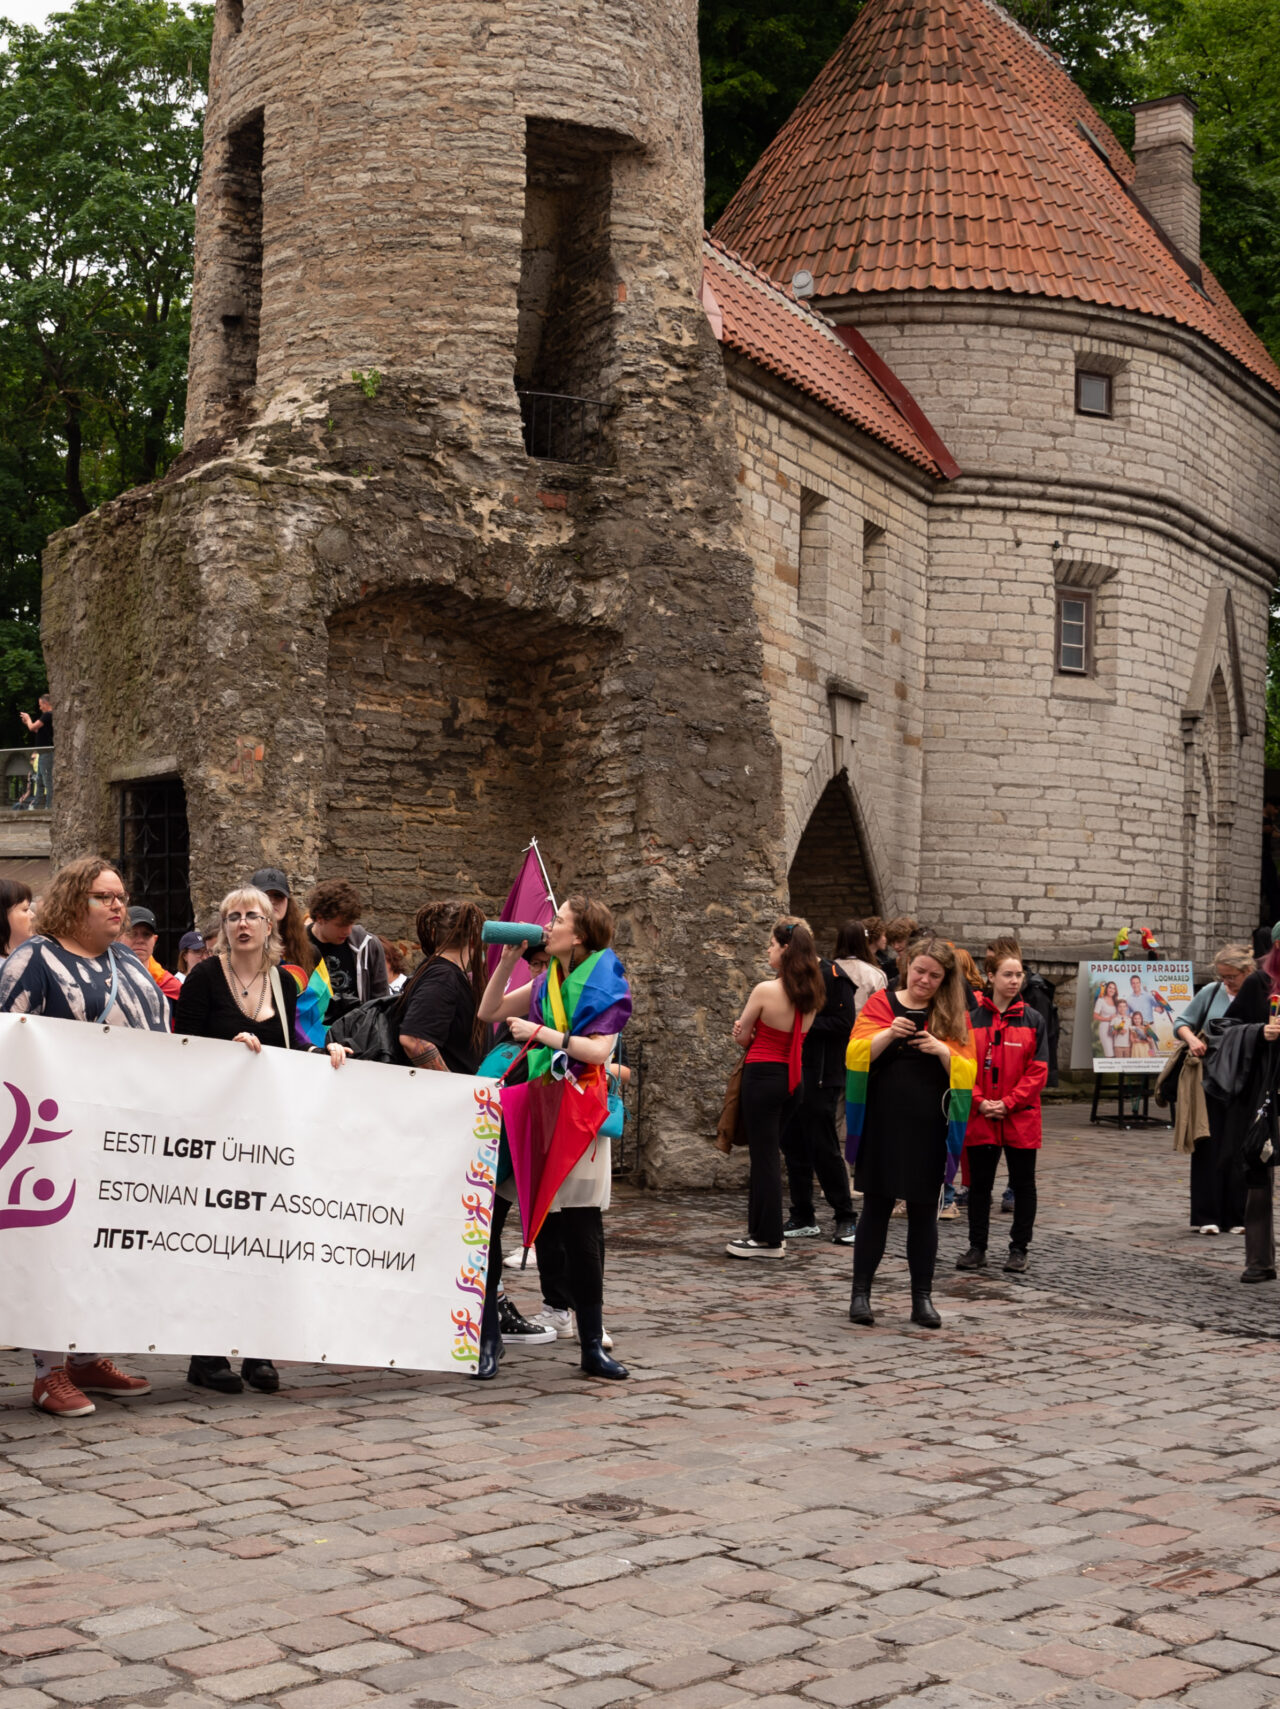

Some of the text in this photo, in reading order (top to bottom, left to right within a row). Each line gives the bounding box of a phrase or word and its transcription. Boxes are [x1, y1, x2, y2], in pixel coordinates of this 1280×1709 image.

[1090, 963, 1190, 973] PAPAGOIDE PARADIIS
[103, 1130, 295, 1166] EESTI LGBT ÜHING
[98, 1179, 405, 1226] ESTONIAN LGBT ASSOCIATION
[93, 1227, 416, 1272] ЛГБТ-АССОЦИАЦИЯ ЭСТОНИИ
